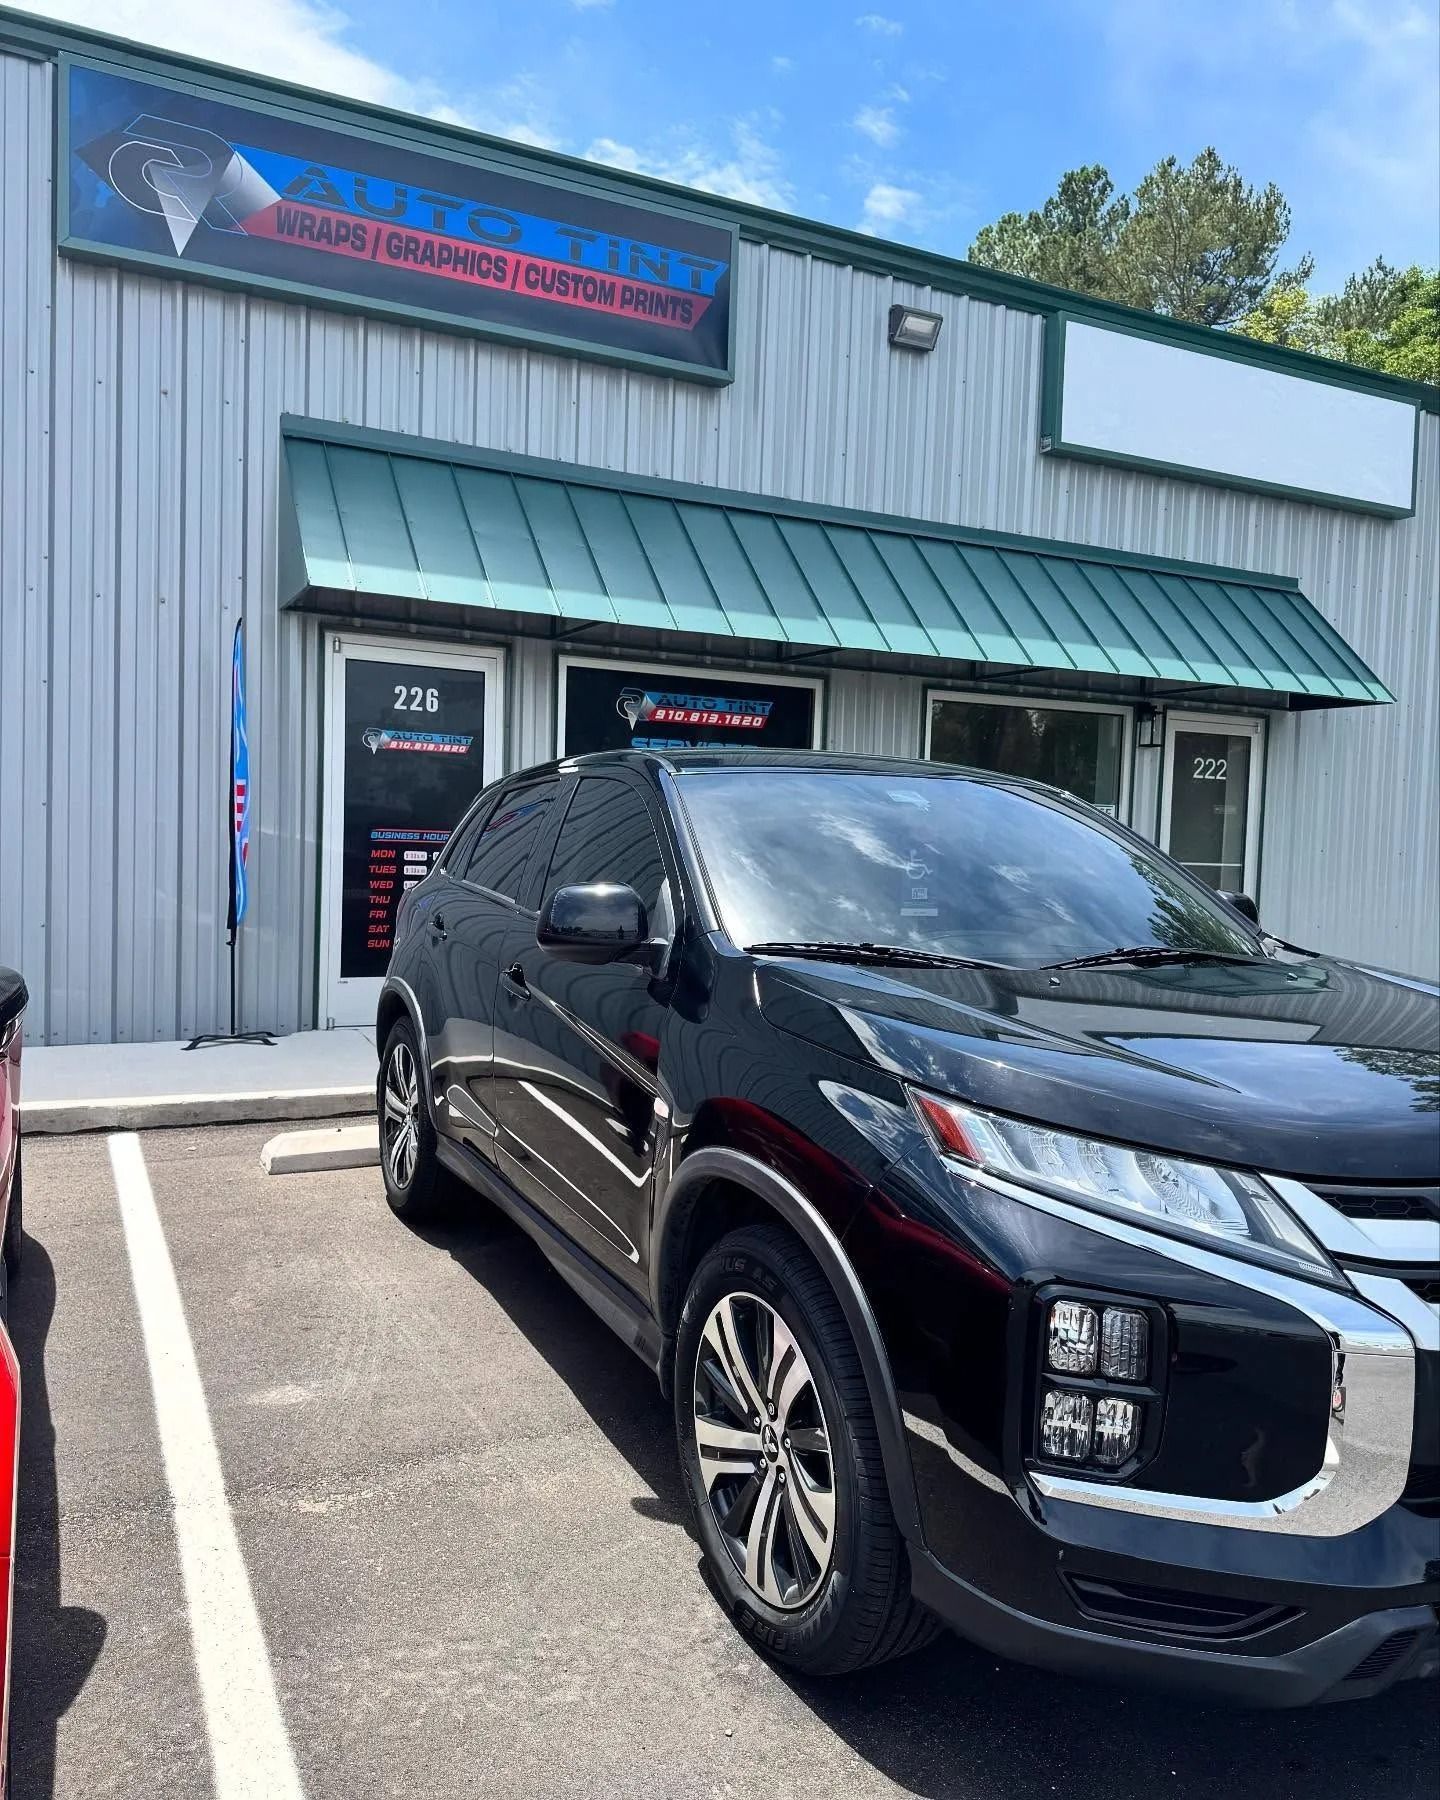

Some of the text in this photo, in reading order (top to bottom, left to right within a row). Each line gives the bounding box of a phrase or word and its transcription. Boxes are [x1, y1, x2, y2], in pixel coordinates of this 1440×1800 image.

[280, 165, 523, 245] AUTO
[276, 206, 368, 252] WRAPS
[385, 231, 508, 283] GRAPHICS
[524, 263, 616, 307] CUSTOM
[620, 285, 694, 325] PRINTS
[393, 685, 439, 713] 226
[657, 694, 717, 710] AUTO
[655, 709, 763, 727] 910.813.1620
[391, 731, 434, 741] AUTO
[1193, 757, 1227, 780] 222
[370, 831, 420, 840] BUSINESS
[370, 849, 396, 858] MON
[369, 865, 397, 874] TUES
[369, 880, 394, 889] WED
[369, 895, 391, 904] THU
[369, 910, 387, 919] FRI
[368, 925, 390, 933] SAT
[367, 939, 391, 948] SUN
